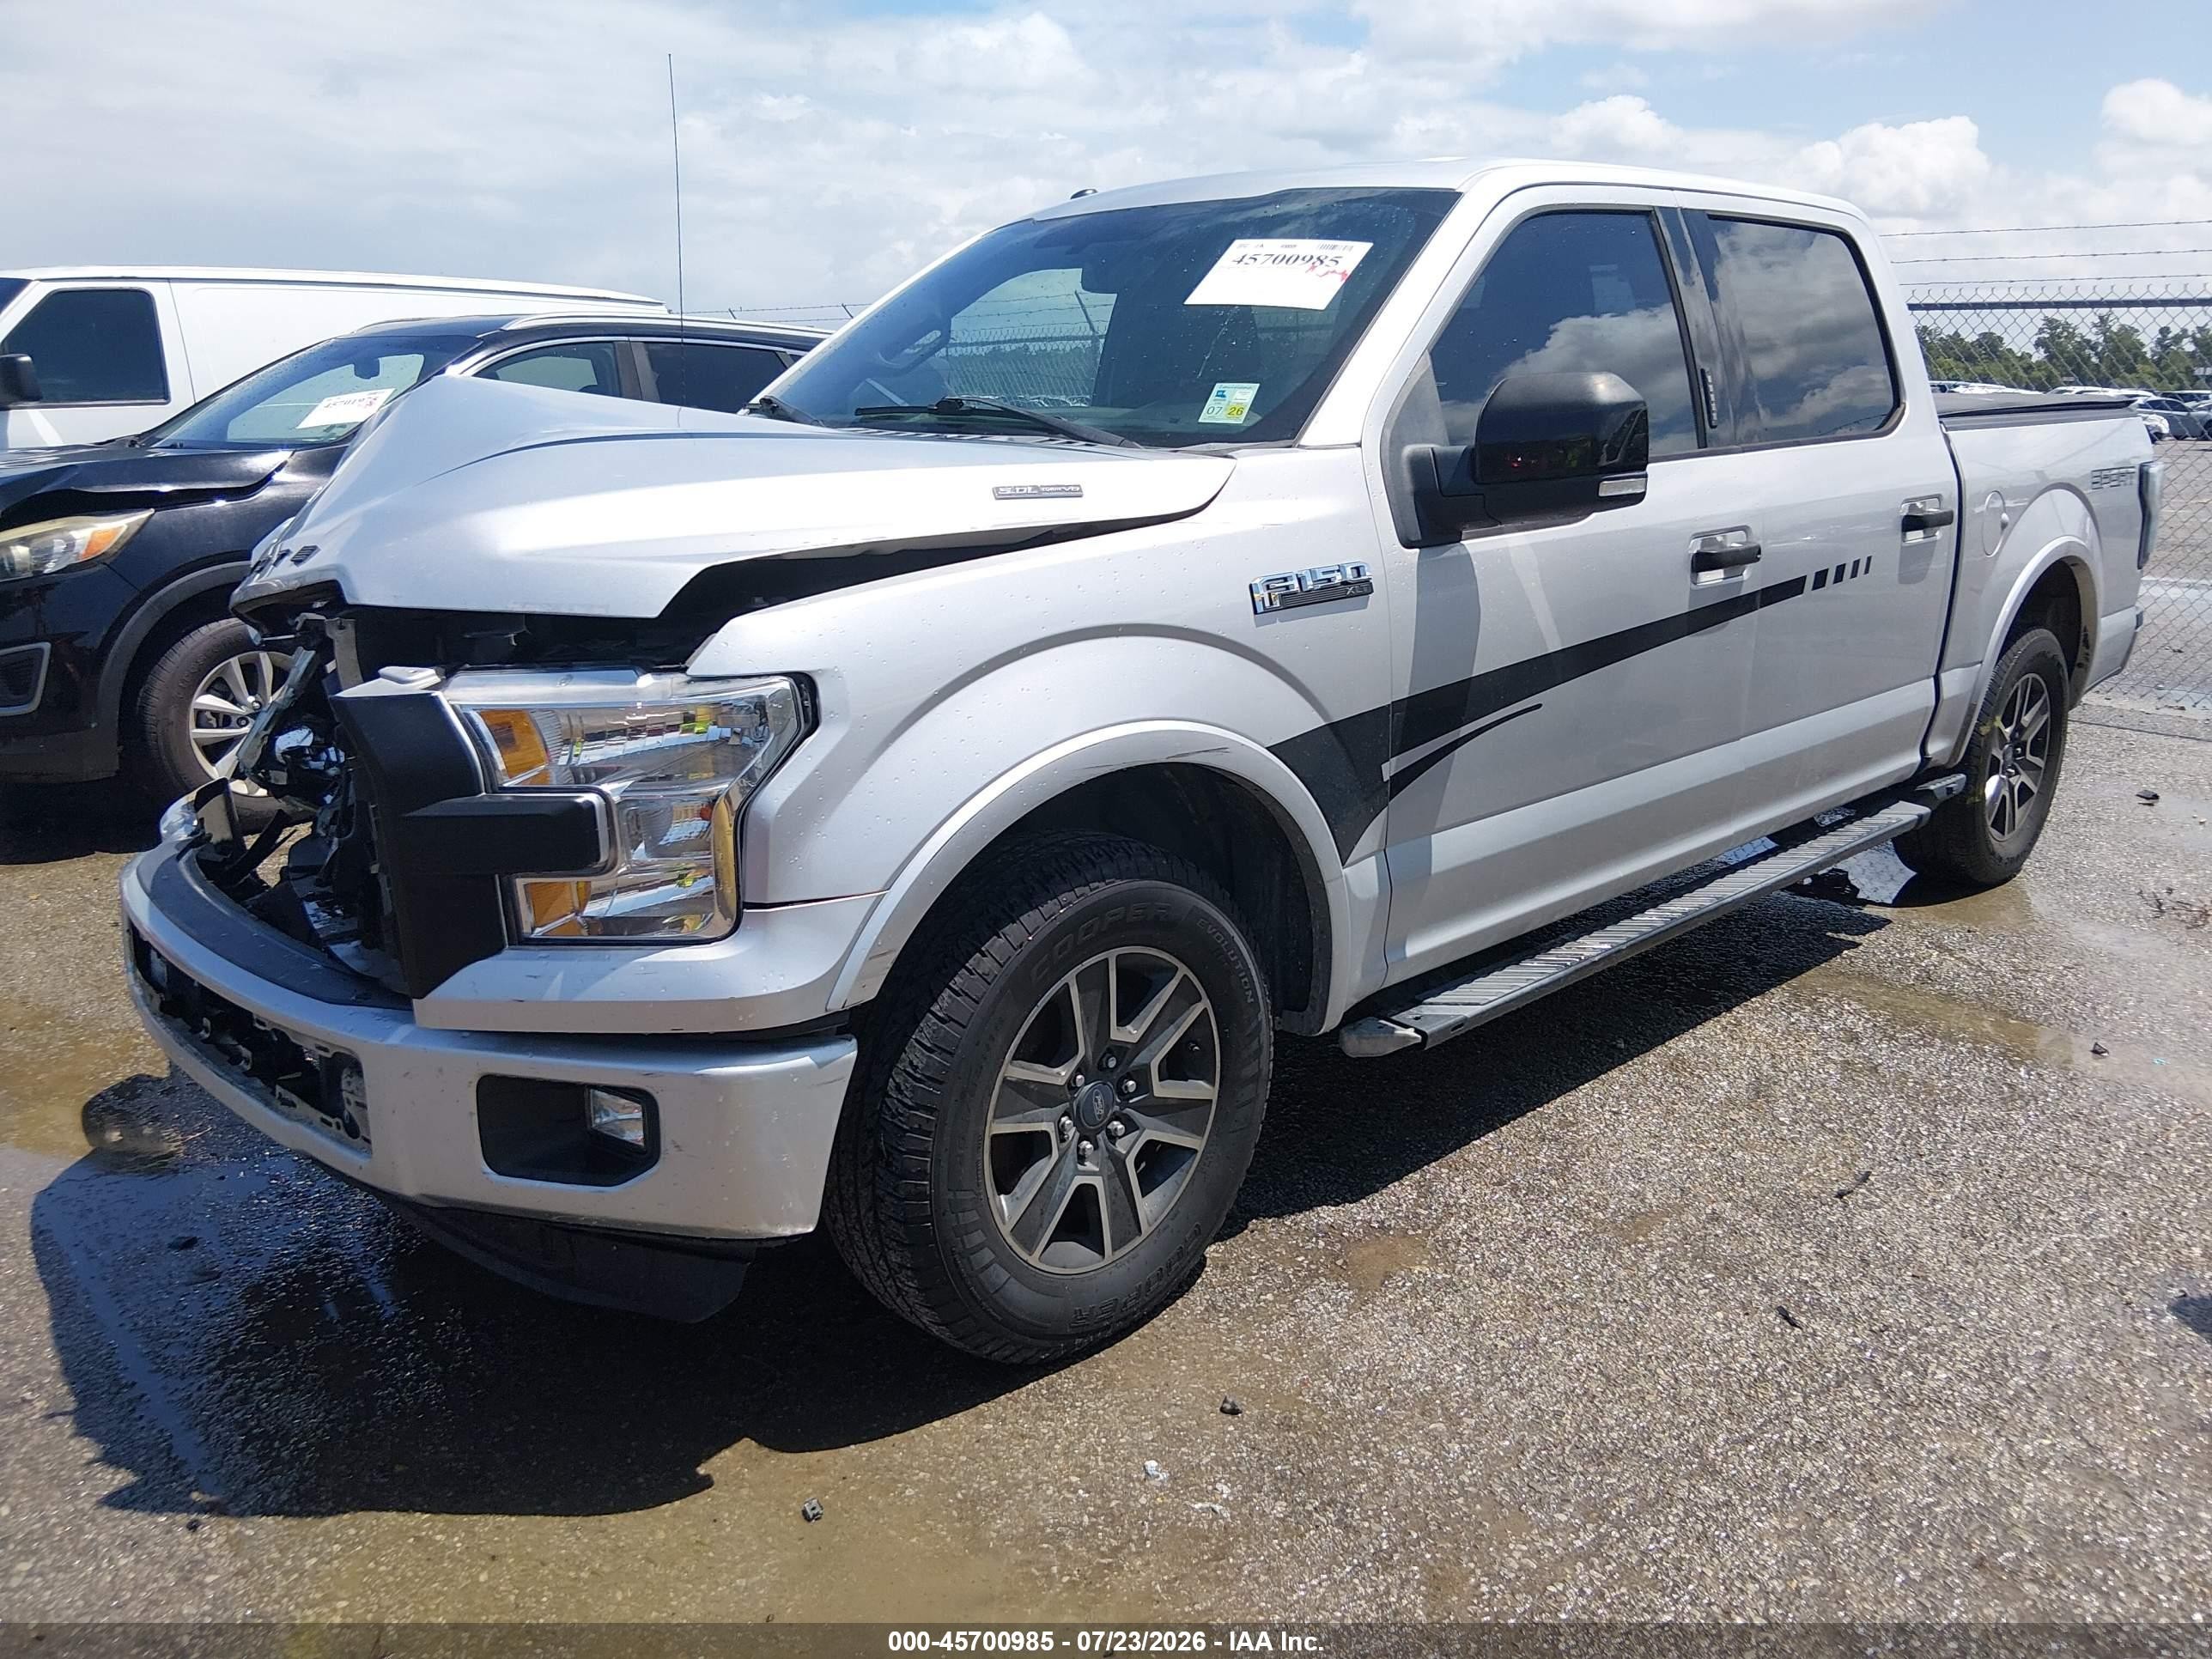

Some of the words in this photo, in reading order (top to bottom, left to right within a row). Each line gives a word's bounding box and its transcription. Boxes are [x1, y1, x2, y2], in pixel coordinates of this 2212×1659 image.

[1231, 252, 1344, 268] 45700985
[1206, 405, 1224, 416] 07
[1228, 406, 1245, 416] 26
[2091, 465, 2136, 490] SPORT
[1346, 584, 1370, 597] XLT
[1030, 901, 1175, 985] COOPER
[1195, 917, 1255, 1005] EVOLUTION
